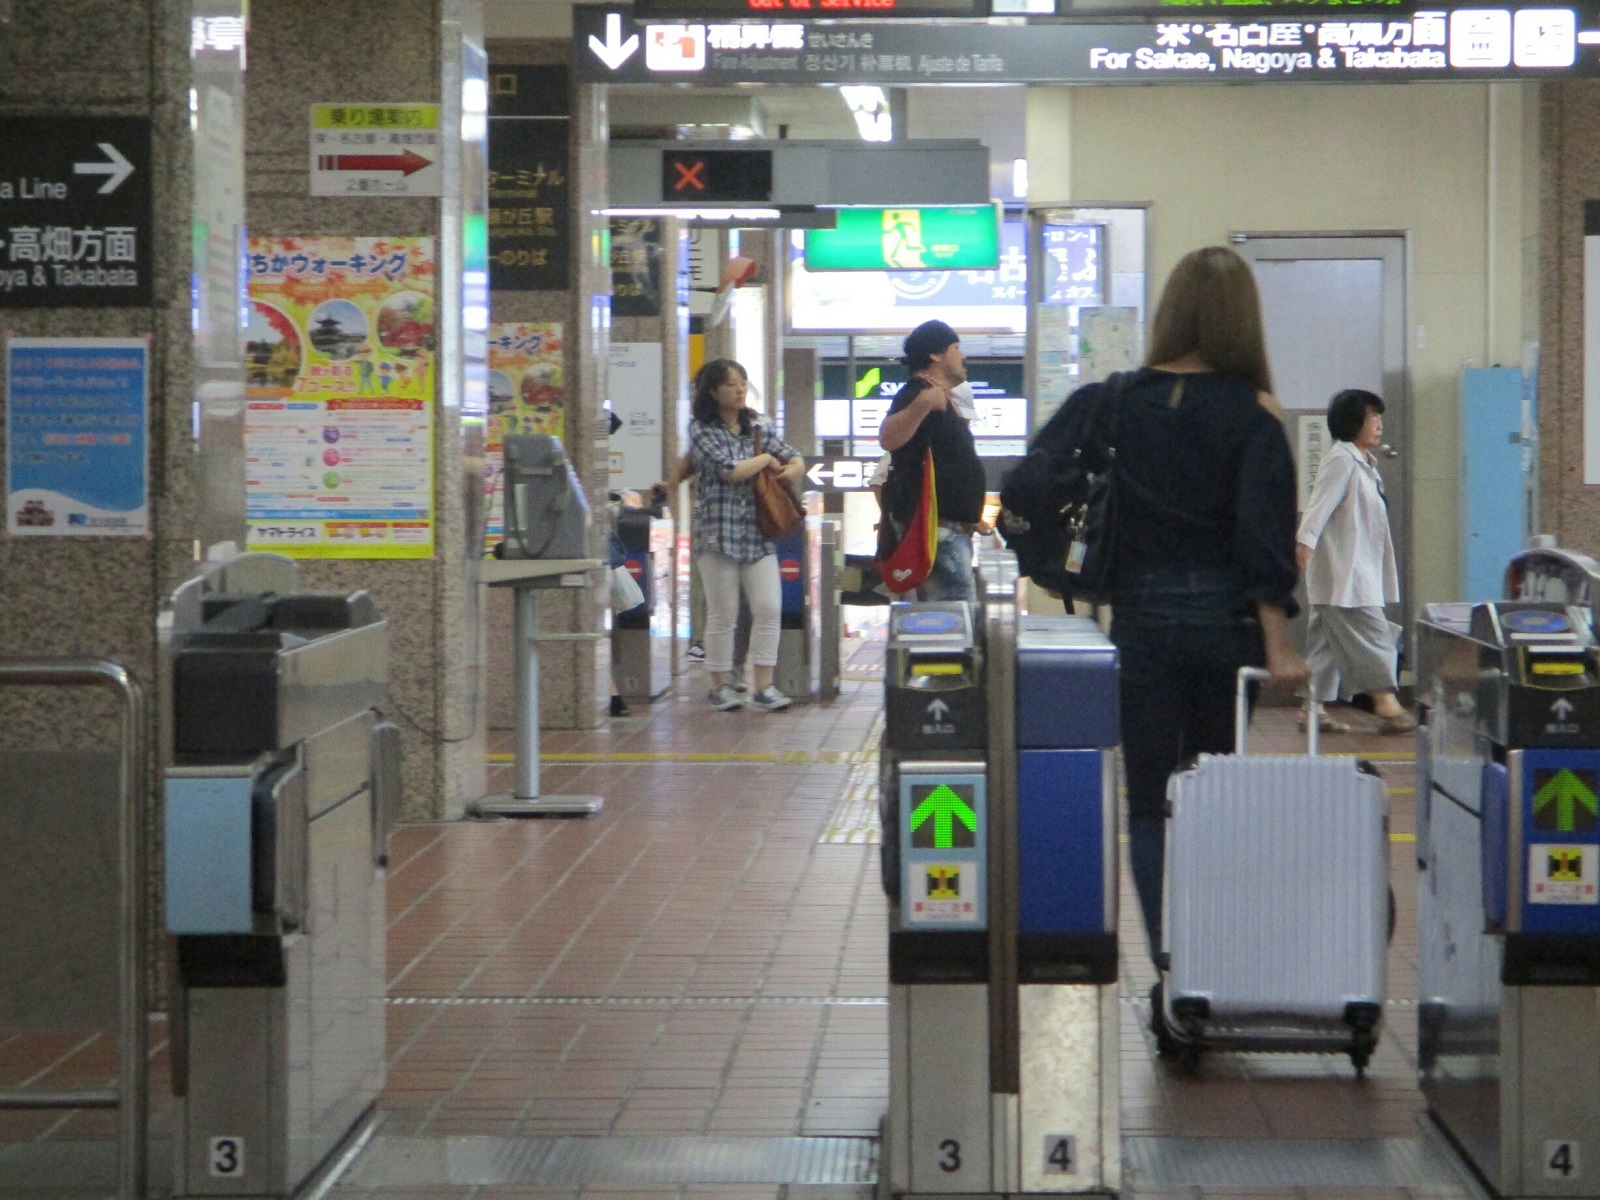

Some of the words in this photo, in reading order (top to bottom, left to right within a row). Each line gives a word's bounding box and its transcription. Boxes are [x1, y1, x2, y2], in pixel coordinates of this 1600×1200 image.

[955, 54, 971, 71] de
[1090, 48, 1131, 69] For
[1135, 48, 1216, 73] Sakae,
[1222, 48, 1313, 73] Nagoya
[1317, 48, 1336, 69] &
[1345, 48, 1447, 69] Takabata
[20, 177, 68, 199] Line
[31, 265, 47, 287] &
[51, 264, 139, 286] Takabata
[215, 1139, 238, 1173] 3
[938, 1138, 962, 1172] 3
[1048, 1137, 1072, 1172] 4
[1549, 1143, 1574, 1177] 4
